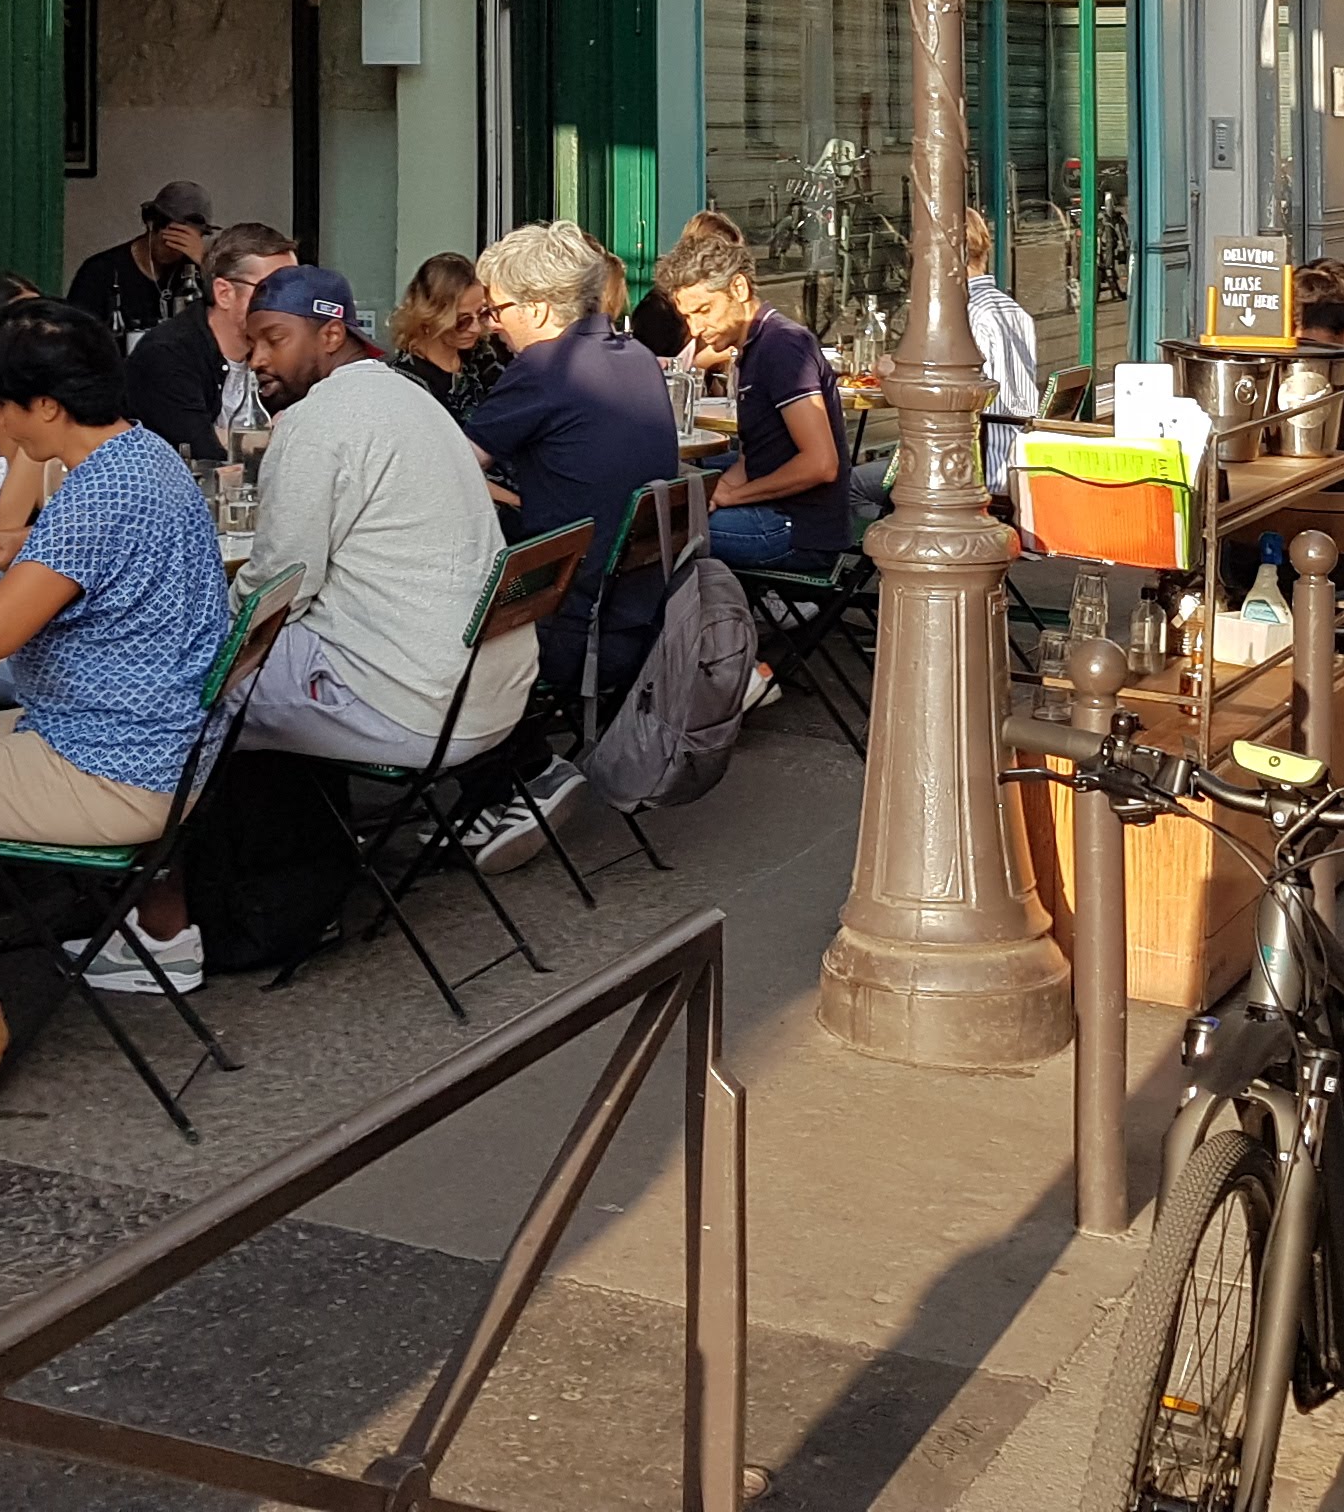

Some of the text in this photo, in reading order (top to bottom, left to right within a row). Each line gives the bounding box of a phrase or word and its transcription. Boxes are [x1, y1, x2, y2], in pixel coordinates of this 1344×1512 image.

[1224, 276, 1262, 292] PLEASE
[1221, 293, 1280, 310] WAIT HERE
